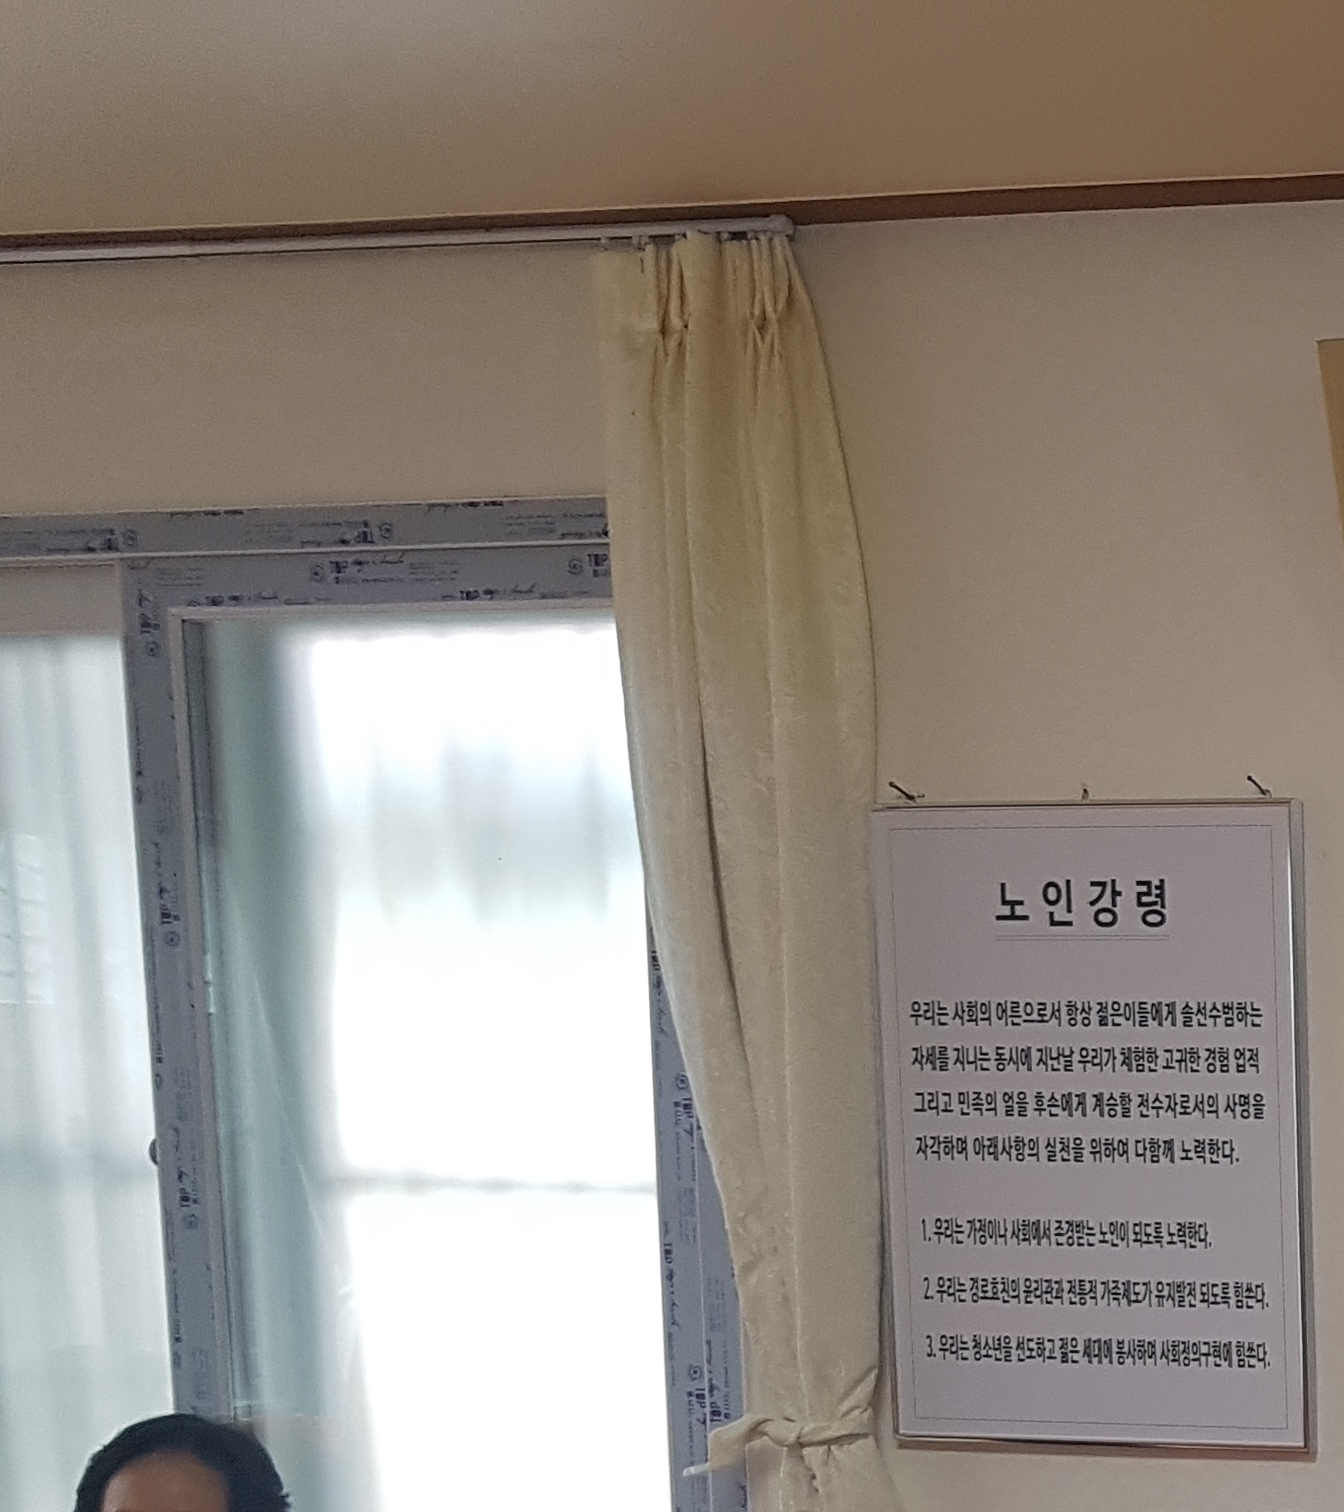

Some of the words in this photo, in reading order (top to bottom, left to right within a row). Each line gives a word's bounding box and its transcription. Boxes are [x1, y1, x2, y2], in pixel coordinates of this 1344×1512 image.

[910, 1001, 949, 1026] 우리는
[952, 1001, 992, 1026] 사회의
[996, 1001, 1062, 1027] 어른으로서
[1065, 1001, 1092, 1027] 항상
[1096, 1001, 1177, 1027] 젊은이들에게
[1181, 1001, 1263, 1027] 솔선수범하는
[912, 1046, 950, 1071] 자세를
[953, 1046, 991, 1071] 지니는
[994, 1046, 1032, 1072] 동시에
[1036, 1046, 1074, 1072] 지난날
[1078, 1046, 1117, 1072] 우리가
[1120, 1047, 1158, 1072] 체험한
[1162, 1047, 1201, 1073] 고귀한
[1205, 1047, 1229, 1074] 경험
[1234, 1047, 1260, 1074] 업적
[914, 1091, 954, 1116] 그리고
[957, 1091, 998, 1116] 민족의
[1002, 1091, 1029, 1117] 얼을
[1033, 1091, 1087, 1117] 후손에게
[1092, 1092, 1132, 1118] 계승할
[1137, 1092, 1220, 1119] 전수자로서의
[1224, 1093, 1266, 1119] 사명을
[915, 1135, 968, 1161] 자각하며
[973, 1136, 1040, 1162] 아래사항의
[1044, 1136, 1086, 1162] 실천을
[1089, 1137, 1129, 1163] 위하여
[1134, 1138, 1175, 1163] 다함께
[1180, 1138, 1240, 1165] 노력한다.
[921, 1218, 932, 1242] 1.
[933, 1217, 965, 1244] 우리는
[967, 1218, 1008, 1246] 가정이나
[1010, 1218, 1051, 1246] 사회에서
[1054, 1219, 1096, 1247] 존경받는
[1098, 1220, 1130, 1248] 노인이
[1132, 1221, 1164, 1248] 되도록
[923, 1276, 934, 1300] 2.
[936, 1276, 967, 1302] 우리는
[969, 1277, 1021, 1304] 경로효친의
[1023, 1278, 1064, 1305] 윤리관과
[1066, 1279, 1098, 1306] 전통적
[1101, 1279, 1153, 1307] 가족제도가
[1155, 1281, 1197, 1308] 유지발전
[1200, 1281, 1231, 1309] 되도록
[1233, 1281, 1269, 1309] 힘쓴다.
[926, 1335, 936, 1358] 3.
[938, 1334, 969, 1360] 우리는
[972, 1334, 1013, 1362] 청소년을
[1015, 1336, 1057, 1363] 선도하고
[1059, 1337, 1080, 1364] 젊은
[1083, 1338, 1113, 1365] 세대에
[1116, 1339, 1157, 1366] 봉사하며
[1160, 1339, 1232, 1368] 사회정의구현에
[1235, 1341, 1271, 1369] 힘쓴다.
